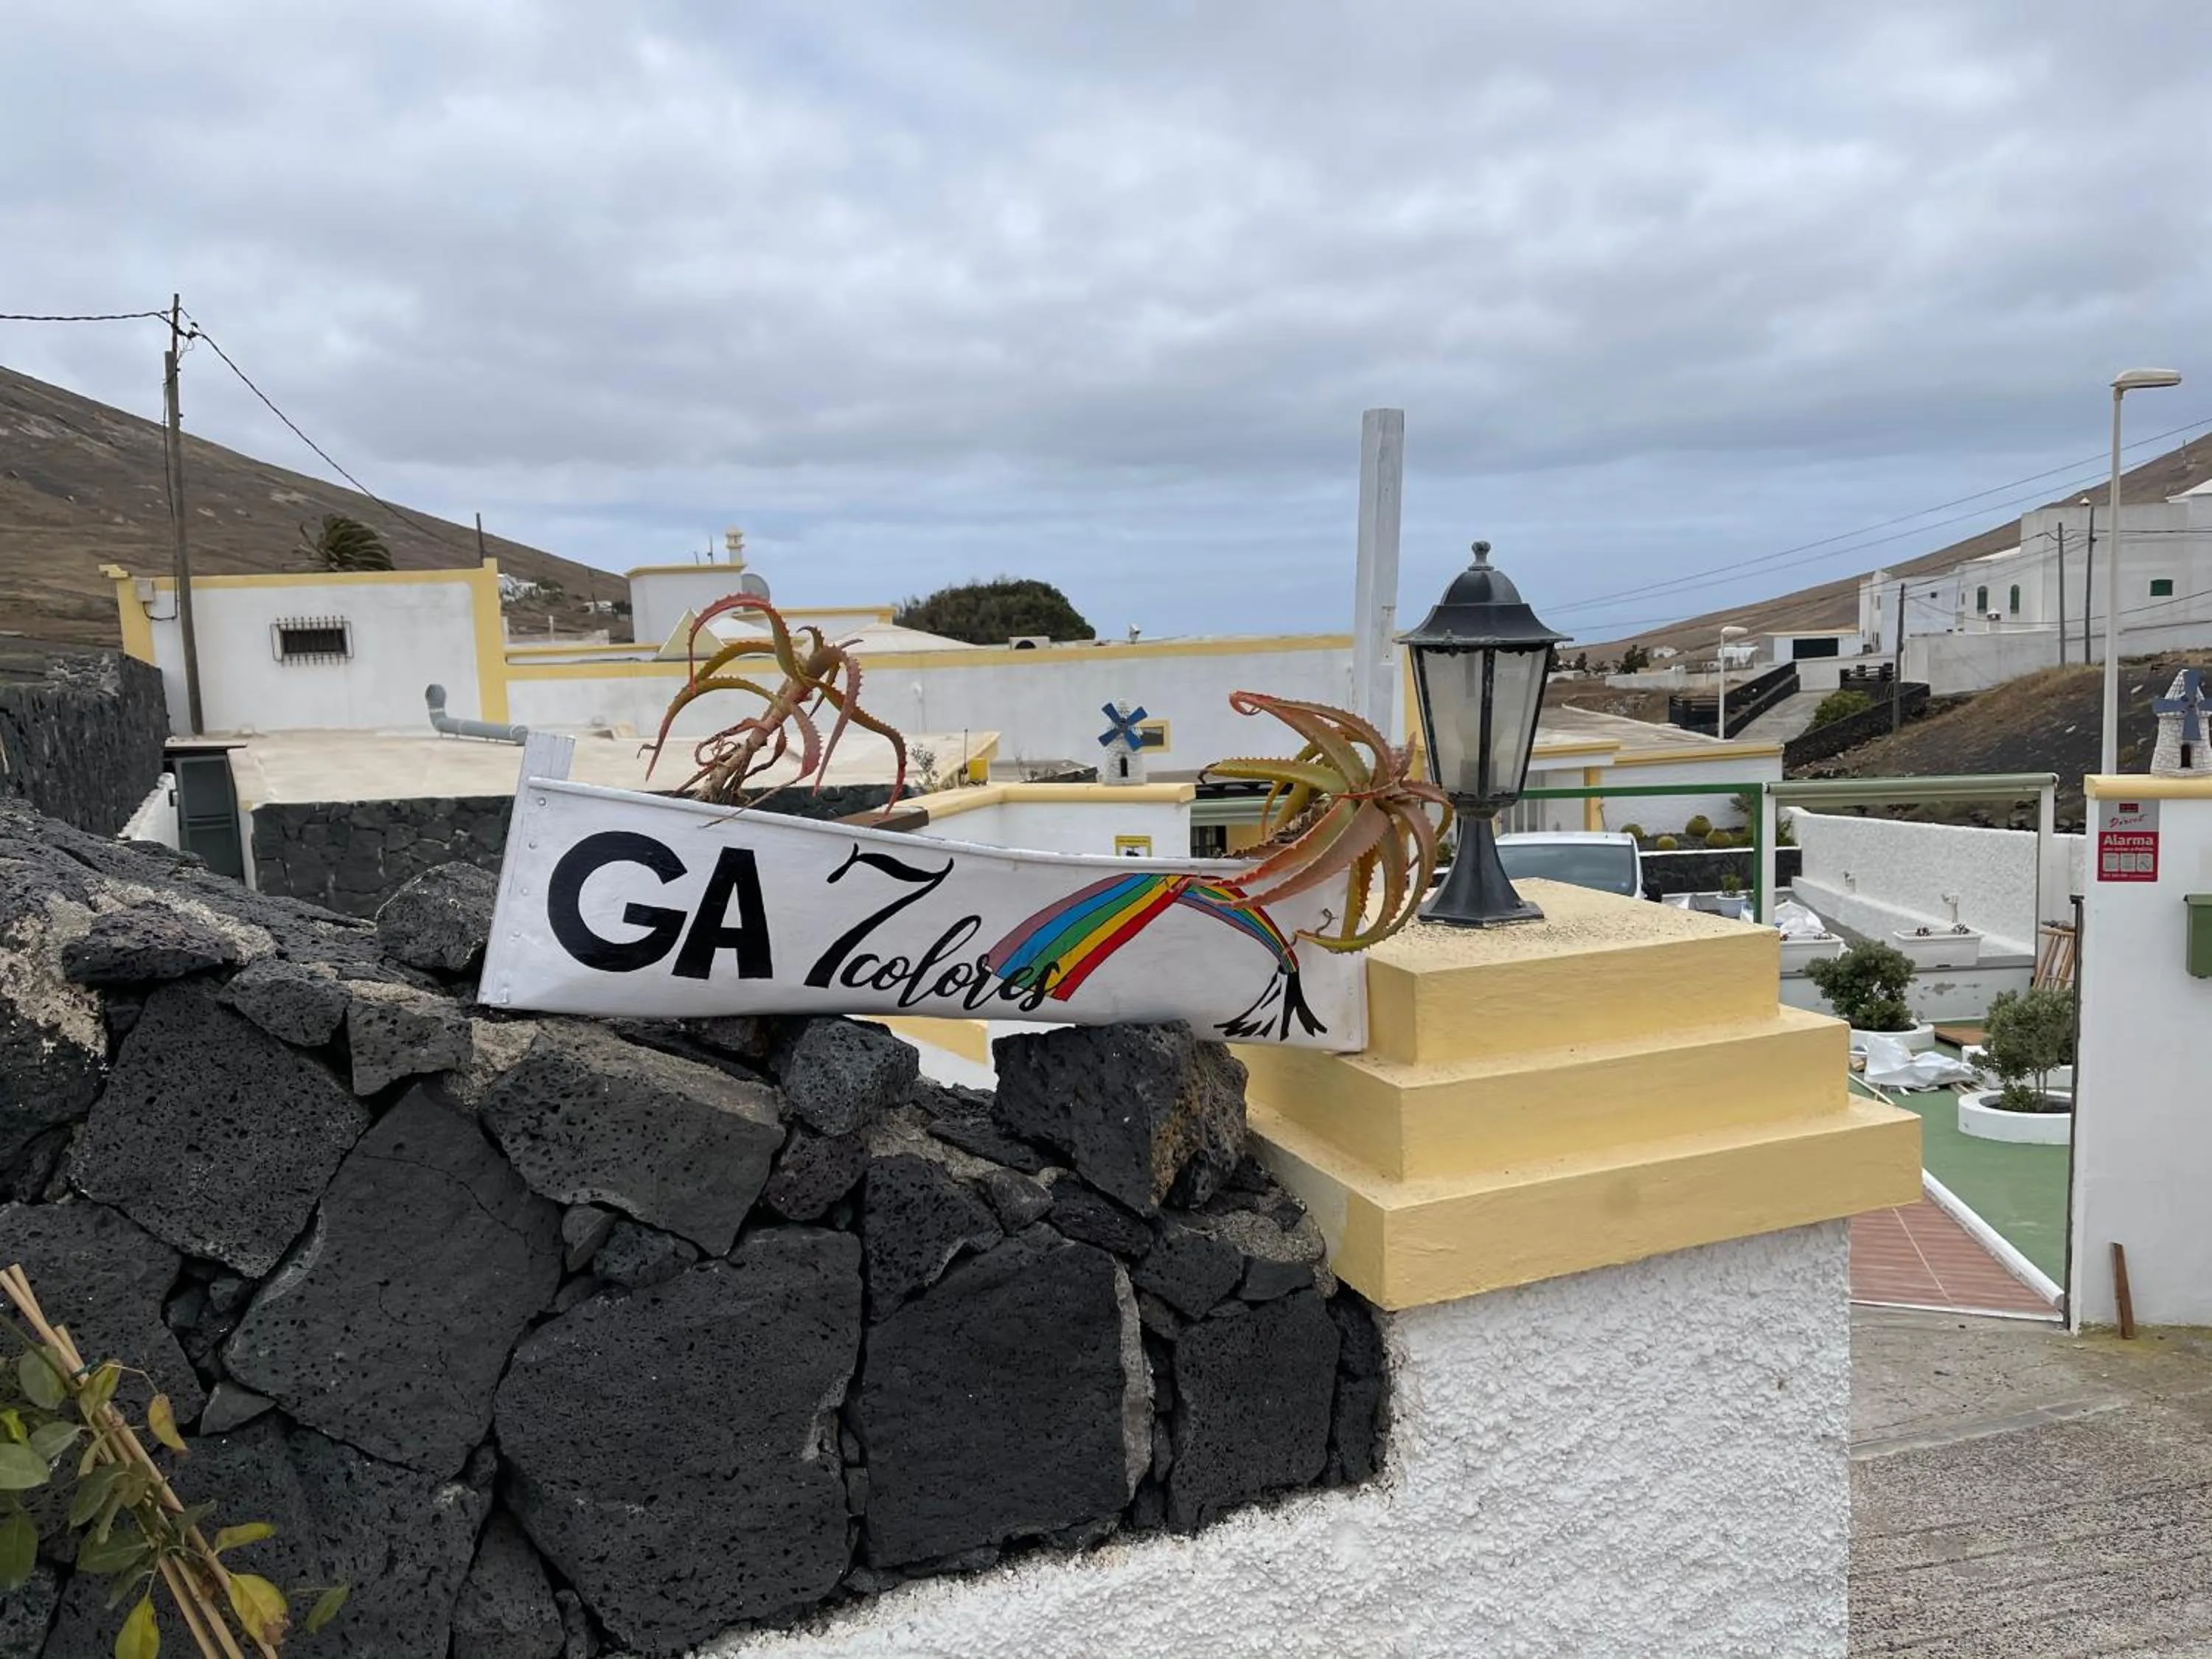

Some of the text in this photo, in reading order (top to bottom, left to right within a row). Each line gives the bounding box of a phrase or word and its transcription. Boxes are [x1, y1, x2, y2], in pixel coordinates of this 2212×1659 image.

[2103, 835, 2154, 846] Alarma
[547, 830, 1067, 1012] GA 7 colores
